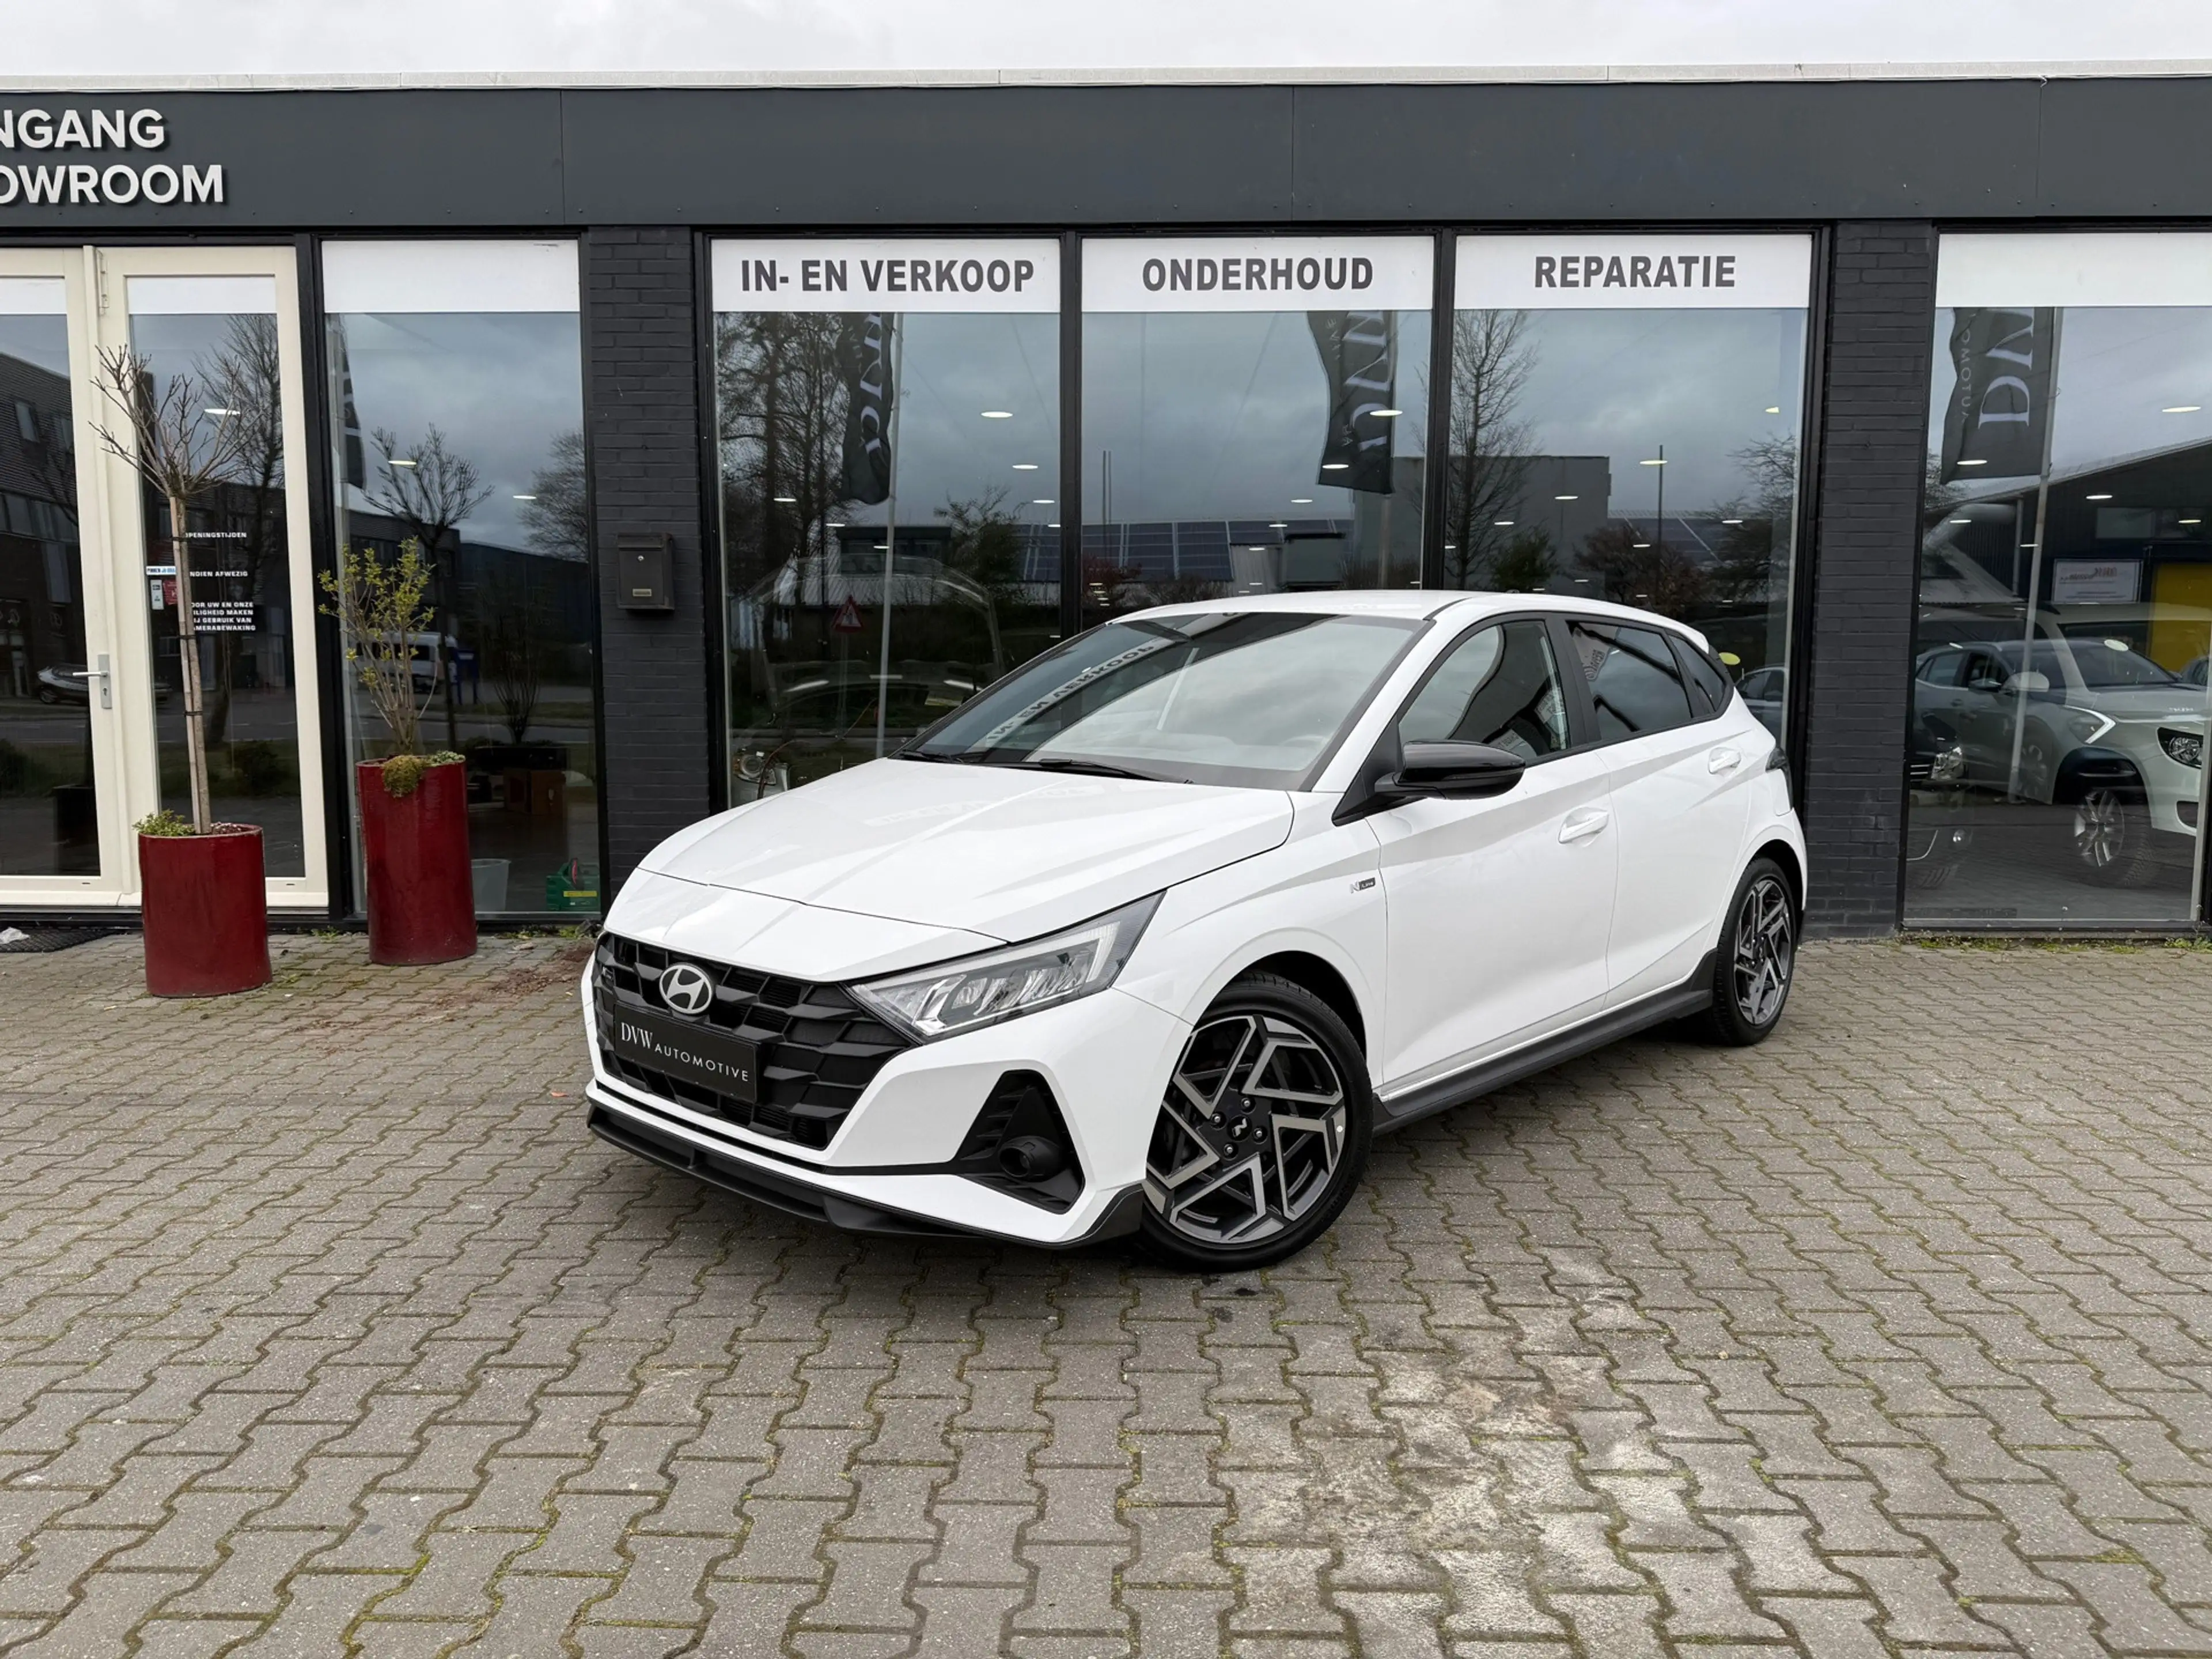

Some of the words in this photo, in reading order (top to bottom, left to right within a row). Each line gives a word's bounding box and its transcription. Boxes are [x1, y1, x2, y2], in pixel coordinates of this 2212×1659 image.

[741, 260, 789, 291] IN-
[801, 260, 847, 291] EN
[860, 259, 1034, 293] VERKOOP
[1142, 257, 1373, 291] ONDERHOUD
[1535, 256, 1736, 288] REPARATIE
[620, 1021, 653, 1050] DVW
[654, 1043, 749, 1082] AUTOMOTIVE
